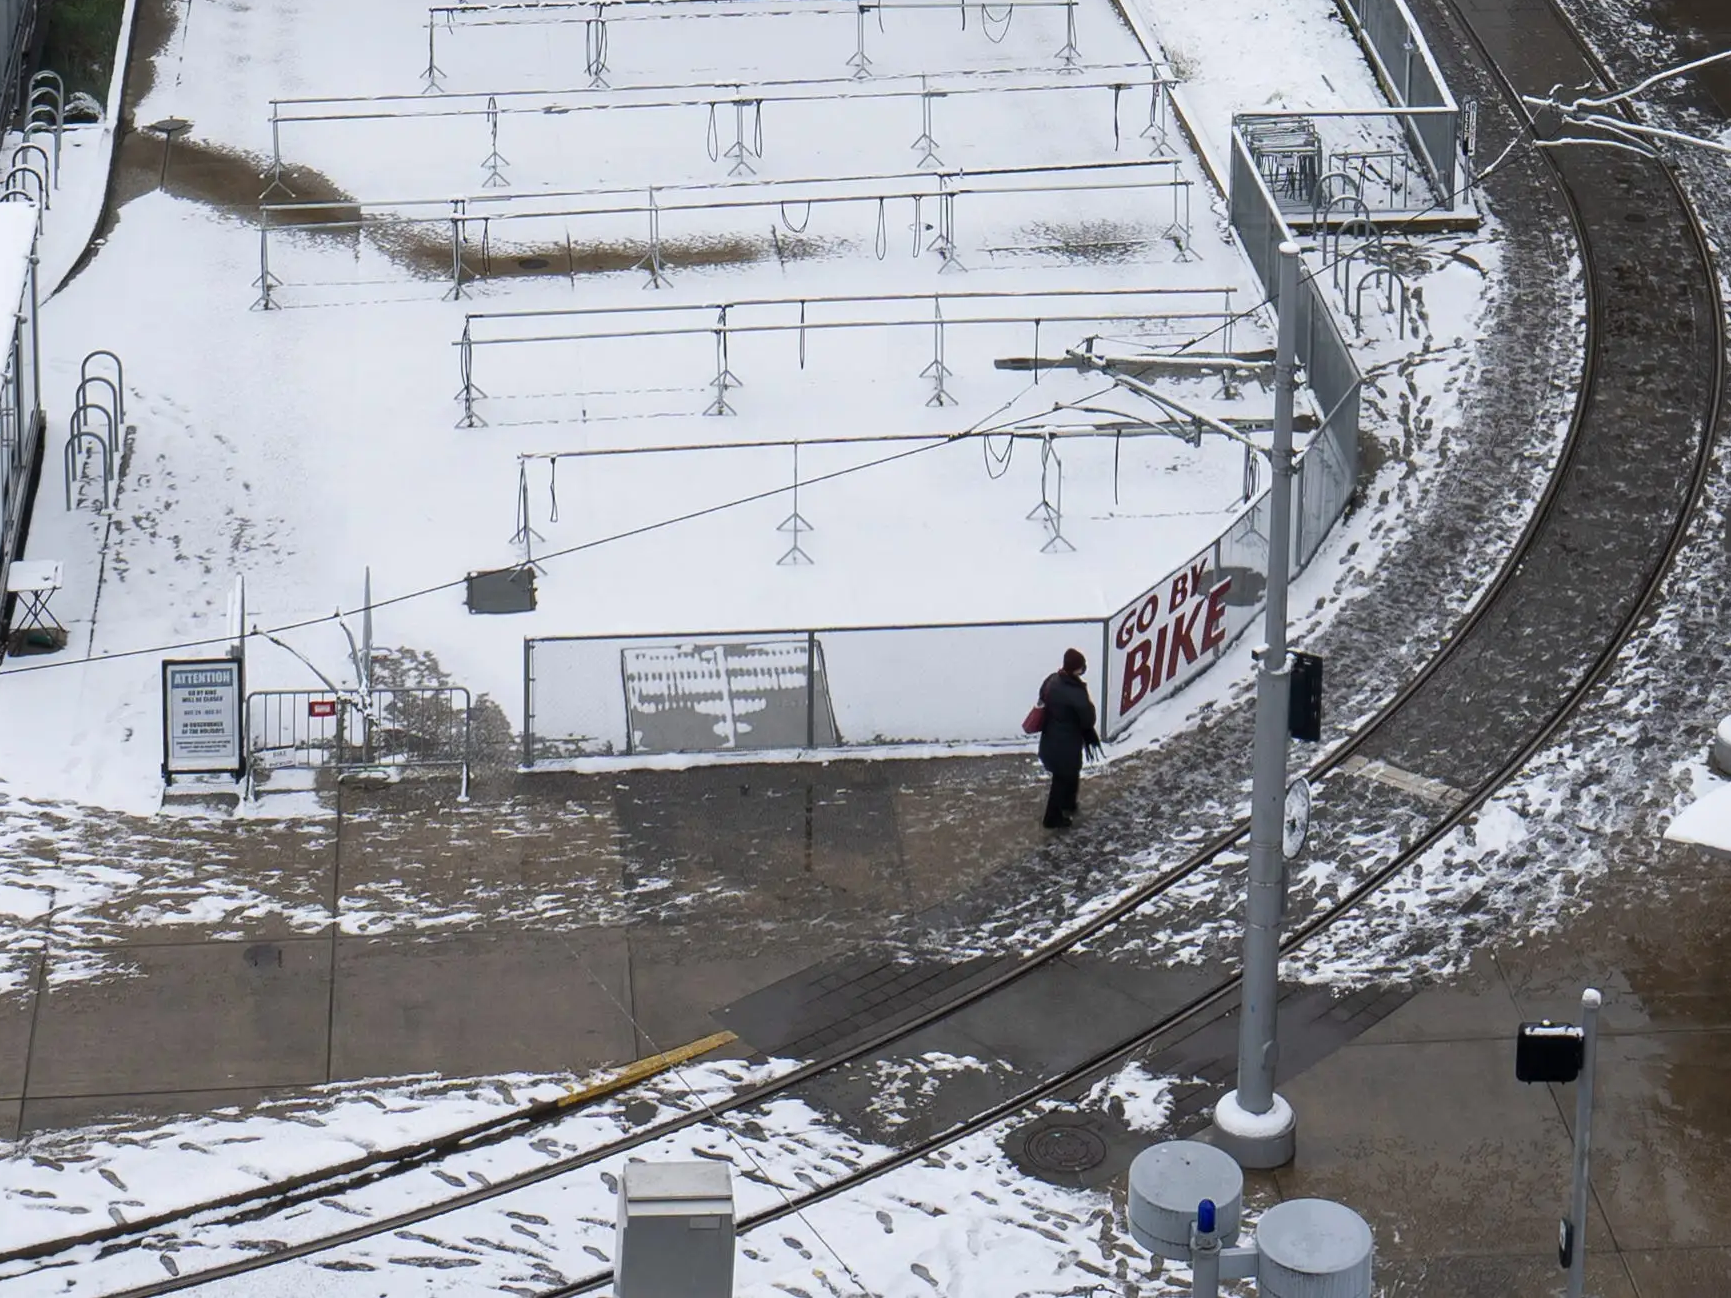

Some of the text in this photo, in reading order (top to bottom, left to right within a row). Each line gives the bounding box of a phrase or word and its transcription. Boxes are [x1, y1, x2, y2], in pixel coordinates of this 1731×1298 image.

[1116, 557, 1209, 650] GO BY
[1120, 575, 1232, 716] BIKE
[174, 670, 230, 684] ATTENTION
